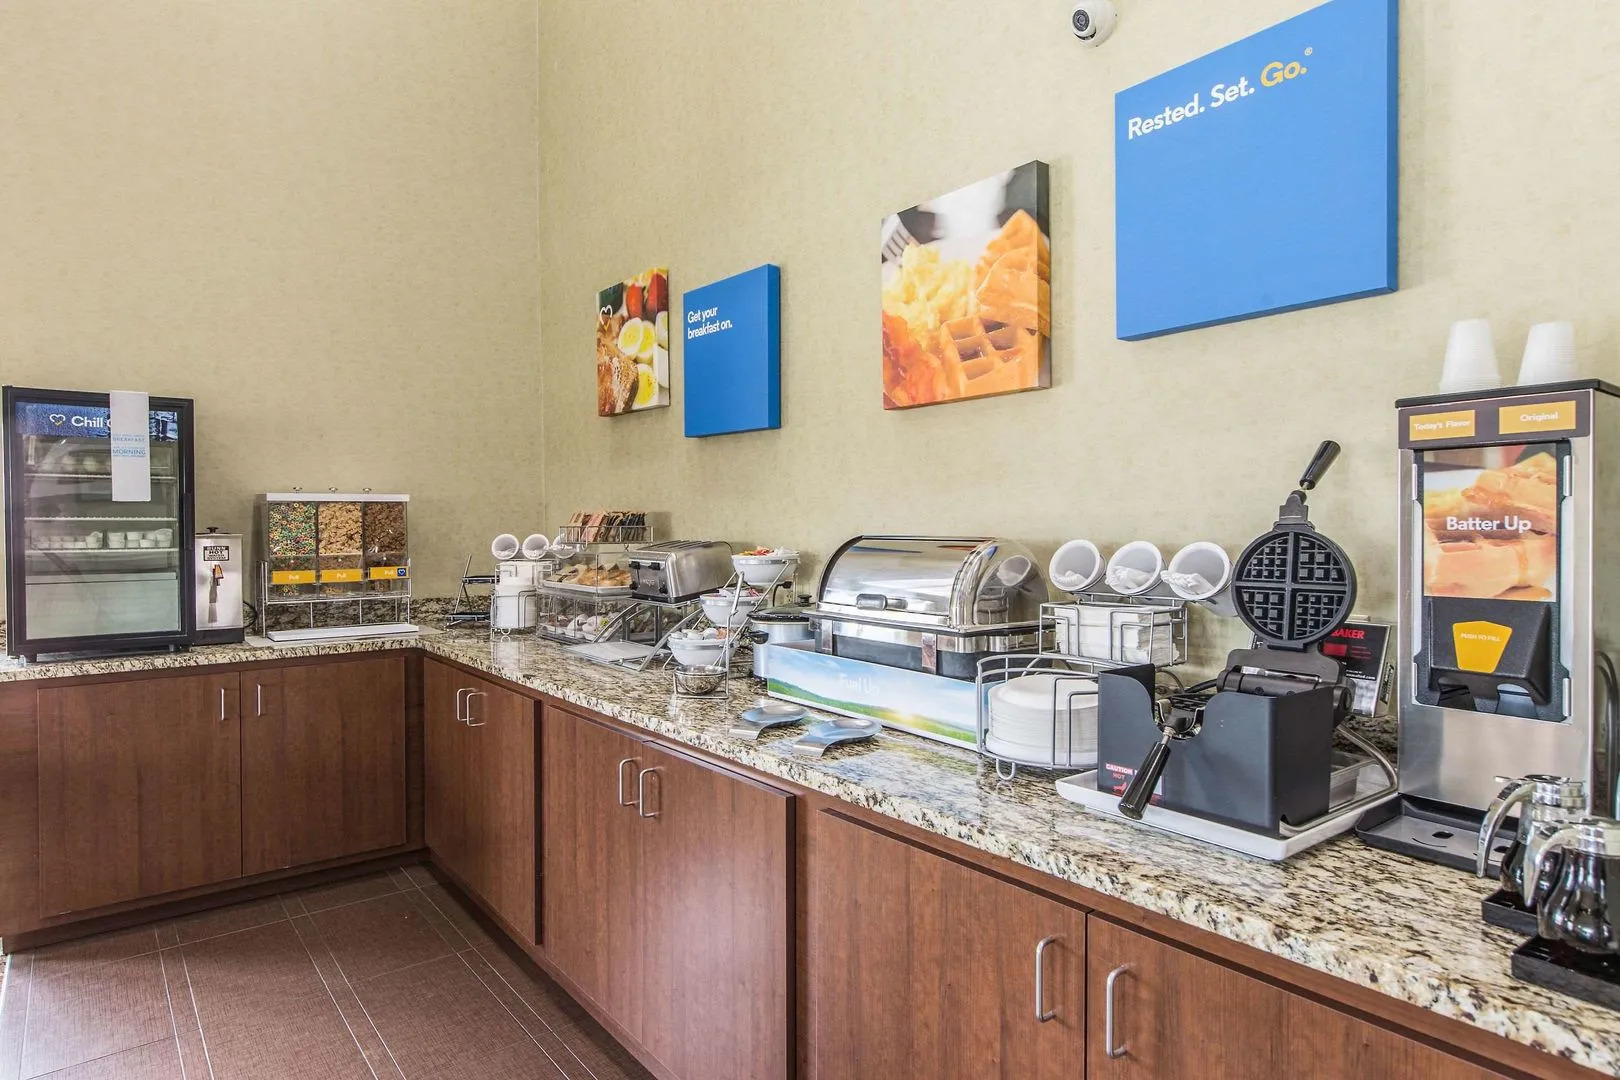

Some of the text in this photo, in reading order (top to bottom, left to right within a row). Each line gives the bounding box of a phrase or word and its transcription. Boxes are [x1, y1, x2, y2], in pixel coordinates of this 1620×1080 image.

[1128, 93, 1205, 140] Rested.
[1210, 76, 1255, 108] Set.
[687, 307, 718, 323] Get your
[687, 319, 733, 339] breakfast on.
[71, 415, 103, 428] Chill
[1520, 411, 1559, 423] Original
[1414, 420, 1472, 431] Today's Flavor
[1446, 515, 1532, 534] Batter Up
[1105, 763, 1133, 775] CAUTION
